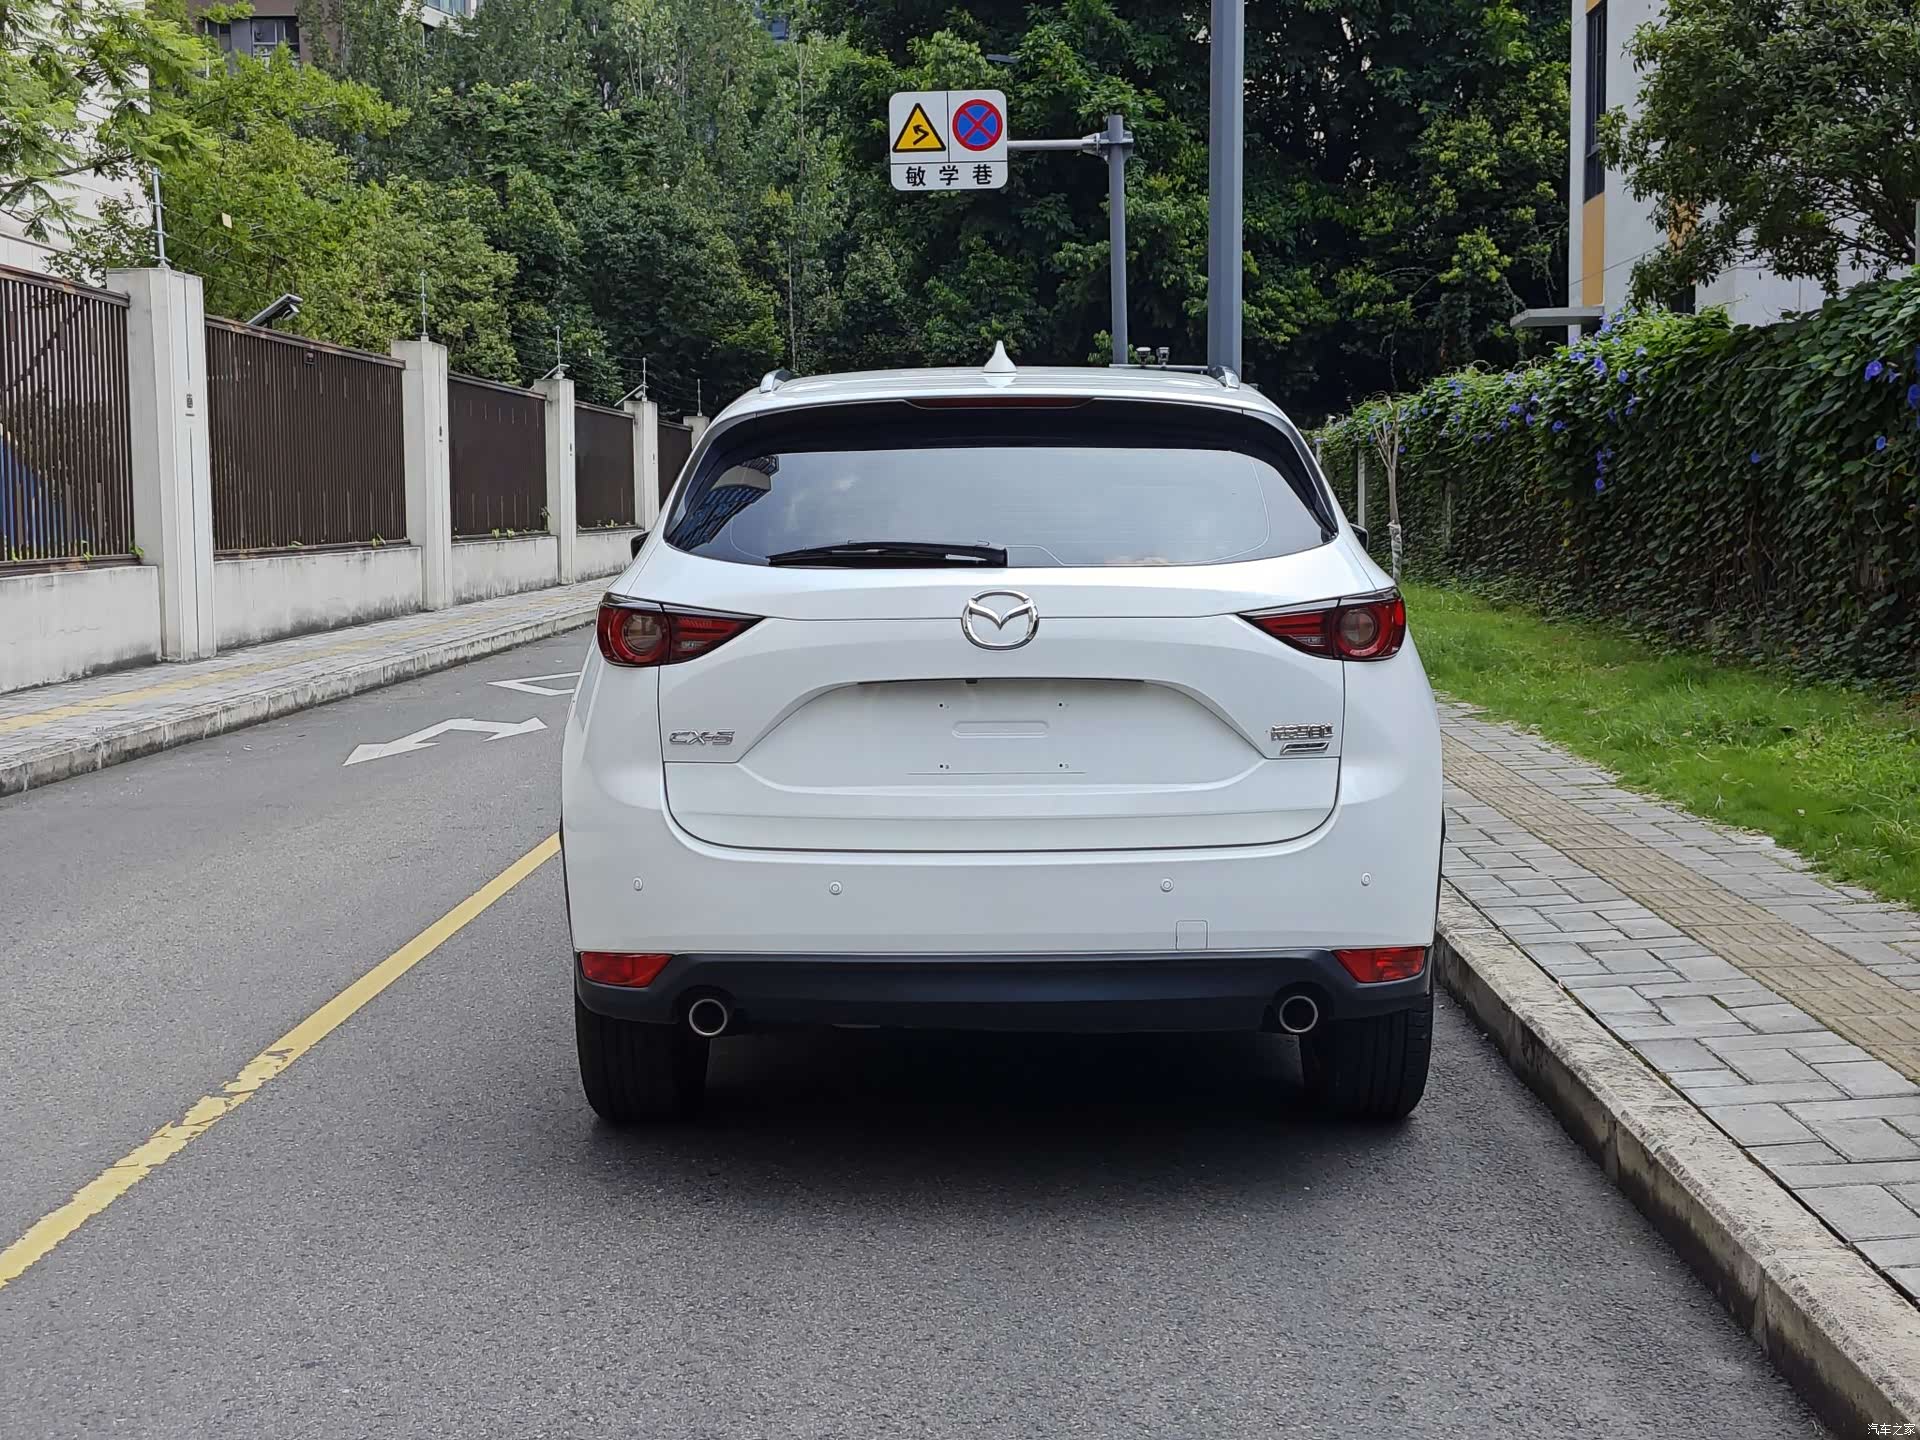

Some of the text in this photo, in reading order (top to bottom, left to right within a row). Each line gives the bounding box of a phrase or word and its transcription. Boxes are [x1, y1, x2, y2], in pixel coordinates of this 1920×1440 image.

[905, 164, 992, 187] 敏学巷
[669, 730, 735, 745] CX-5
